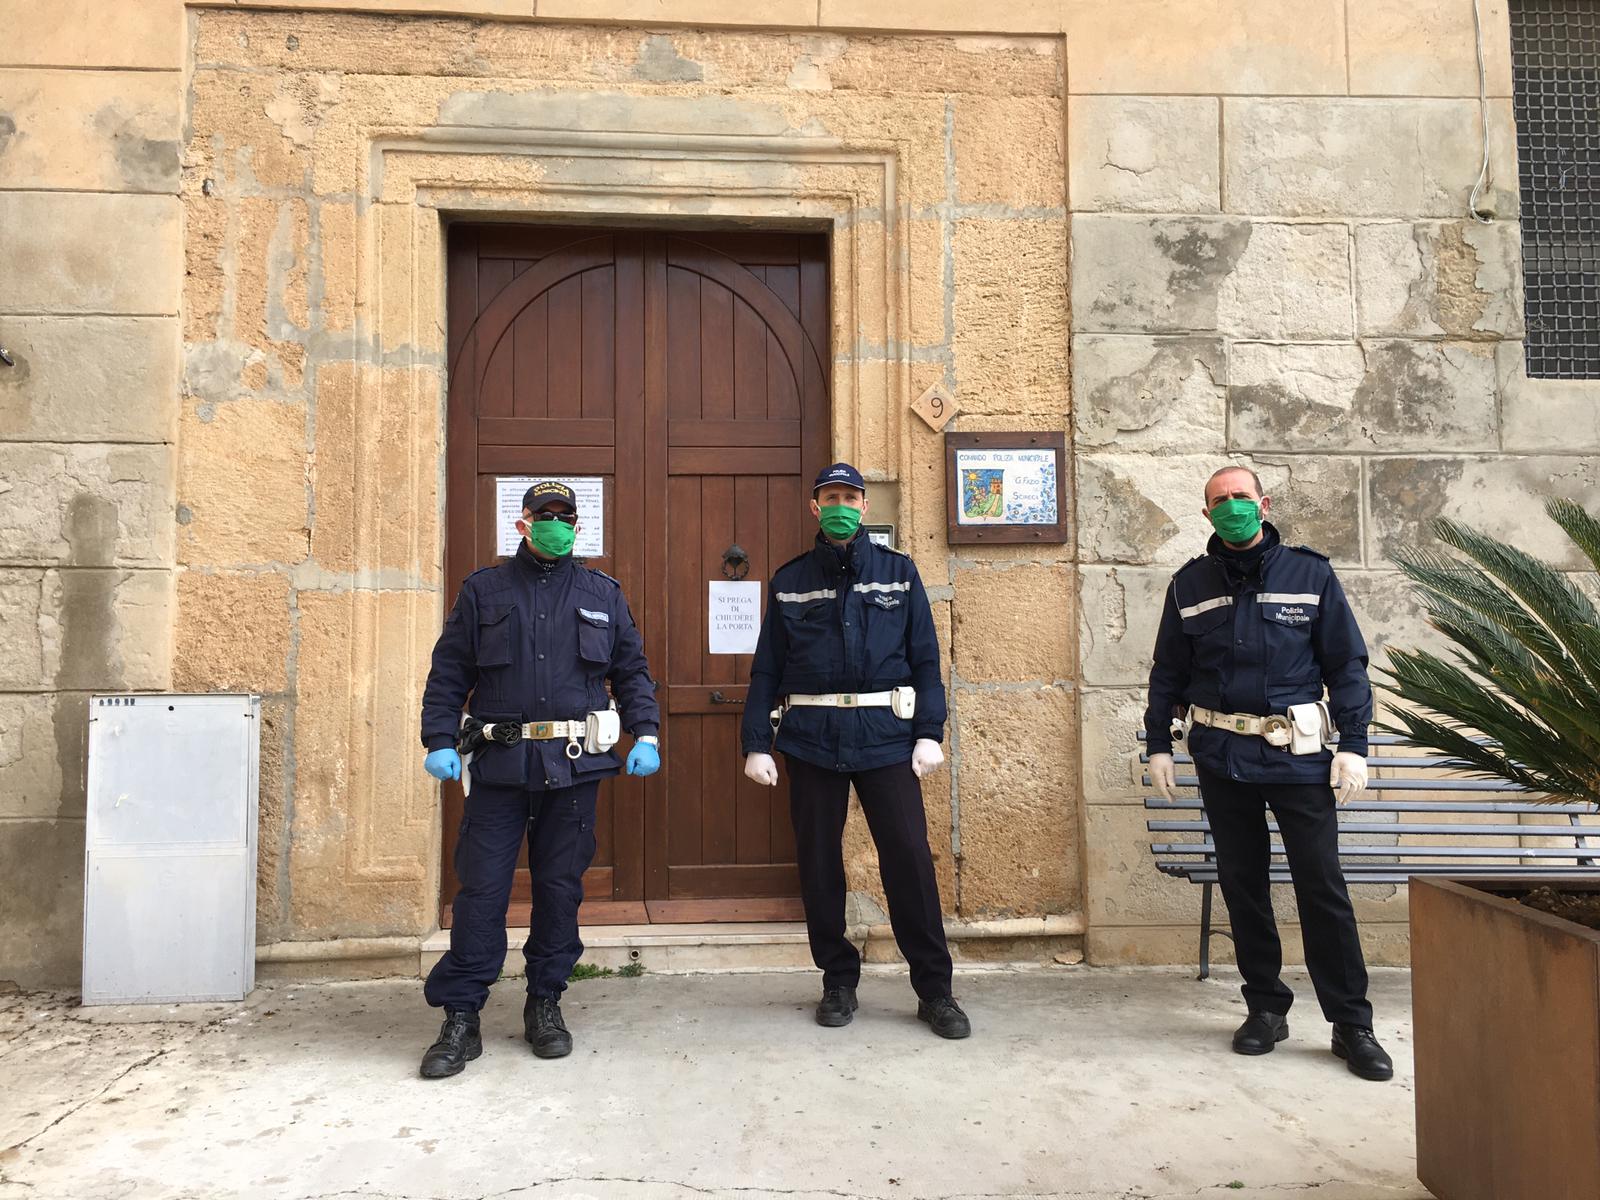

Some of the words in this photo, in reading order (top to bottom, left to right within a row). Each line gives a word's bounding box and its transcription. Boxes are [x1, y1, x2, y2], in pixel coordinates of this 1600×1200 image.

[930, 397, 944, 419] 9
[718, 596, 726, 604] SI
[727, 596, 753, 604] PREGA
[730, 605, 740, 613] DI
[1281, 606, 1304, 614] Polizia
[715, 614, 754, 622] CHIUDERE
[1275, 612, 1310, 622] Municipale
[716, 623, 727, 631] LA
[728, 623, 753, 631] PORTA
